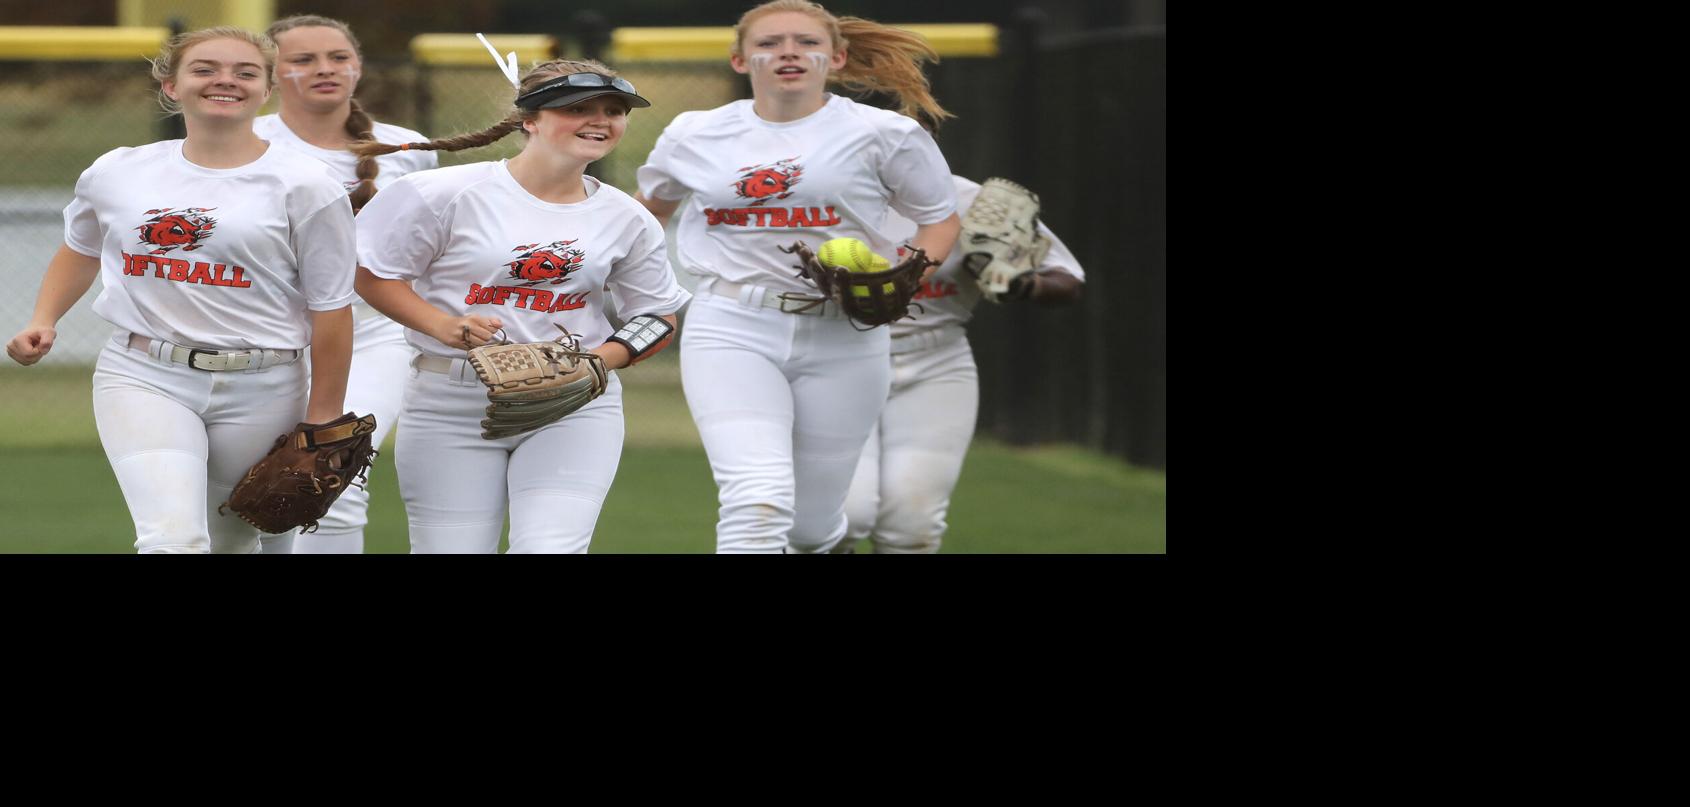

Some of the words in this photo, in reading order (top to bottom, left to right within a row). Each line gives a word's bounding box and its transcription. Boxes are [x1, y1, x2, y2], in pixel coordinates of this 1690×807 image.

[704, 206, 841, 228] SOFTBALL
[121, 251, 251, 288] OFTBALL
[465, 283, 591, 313] SOFTBALL
